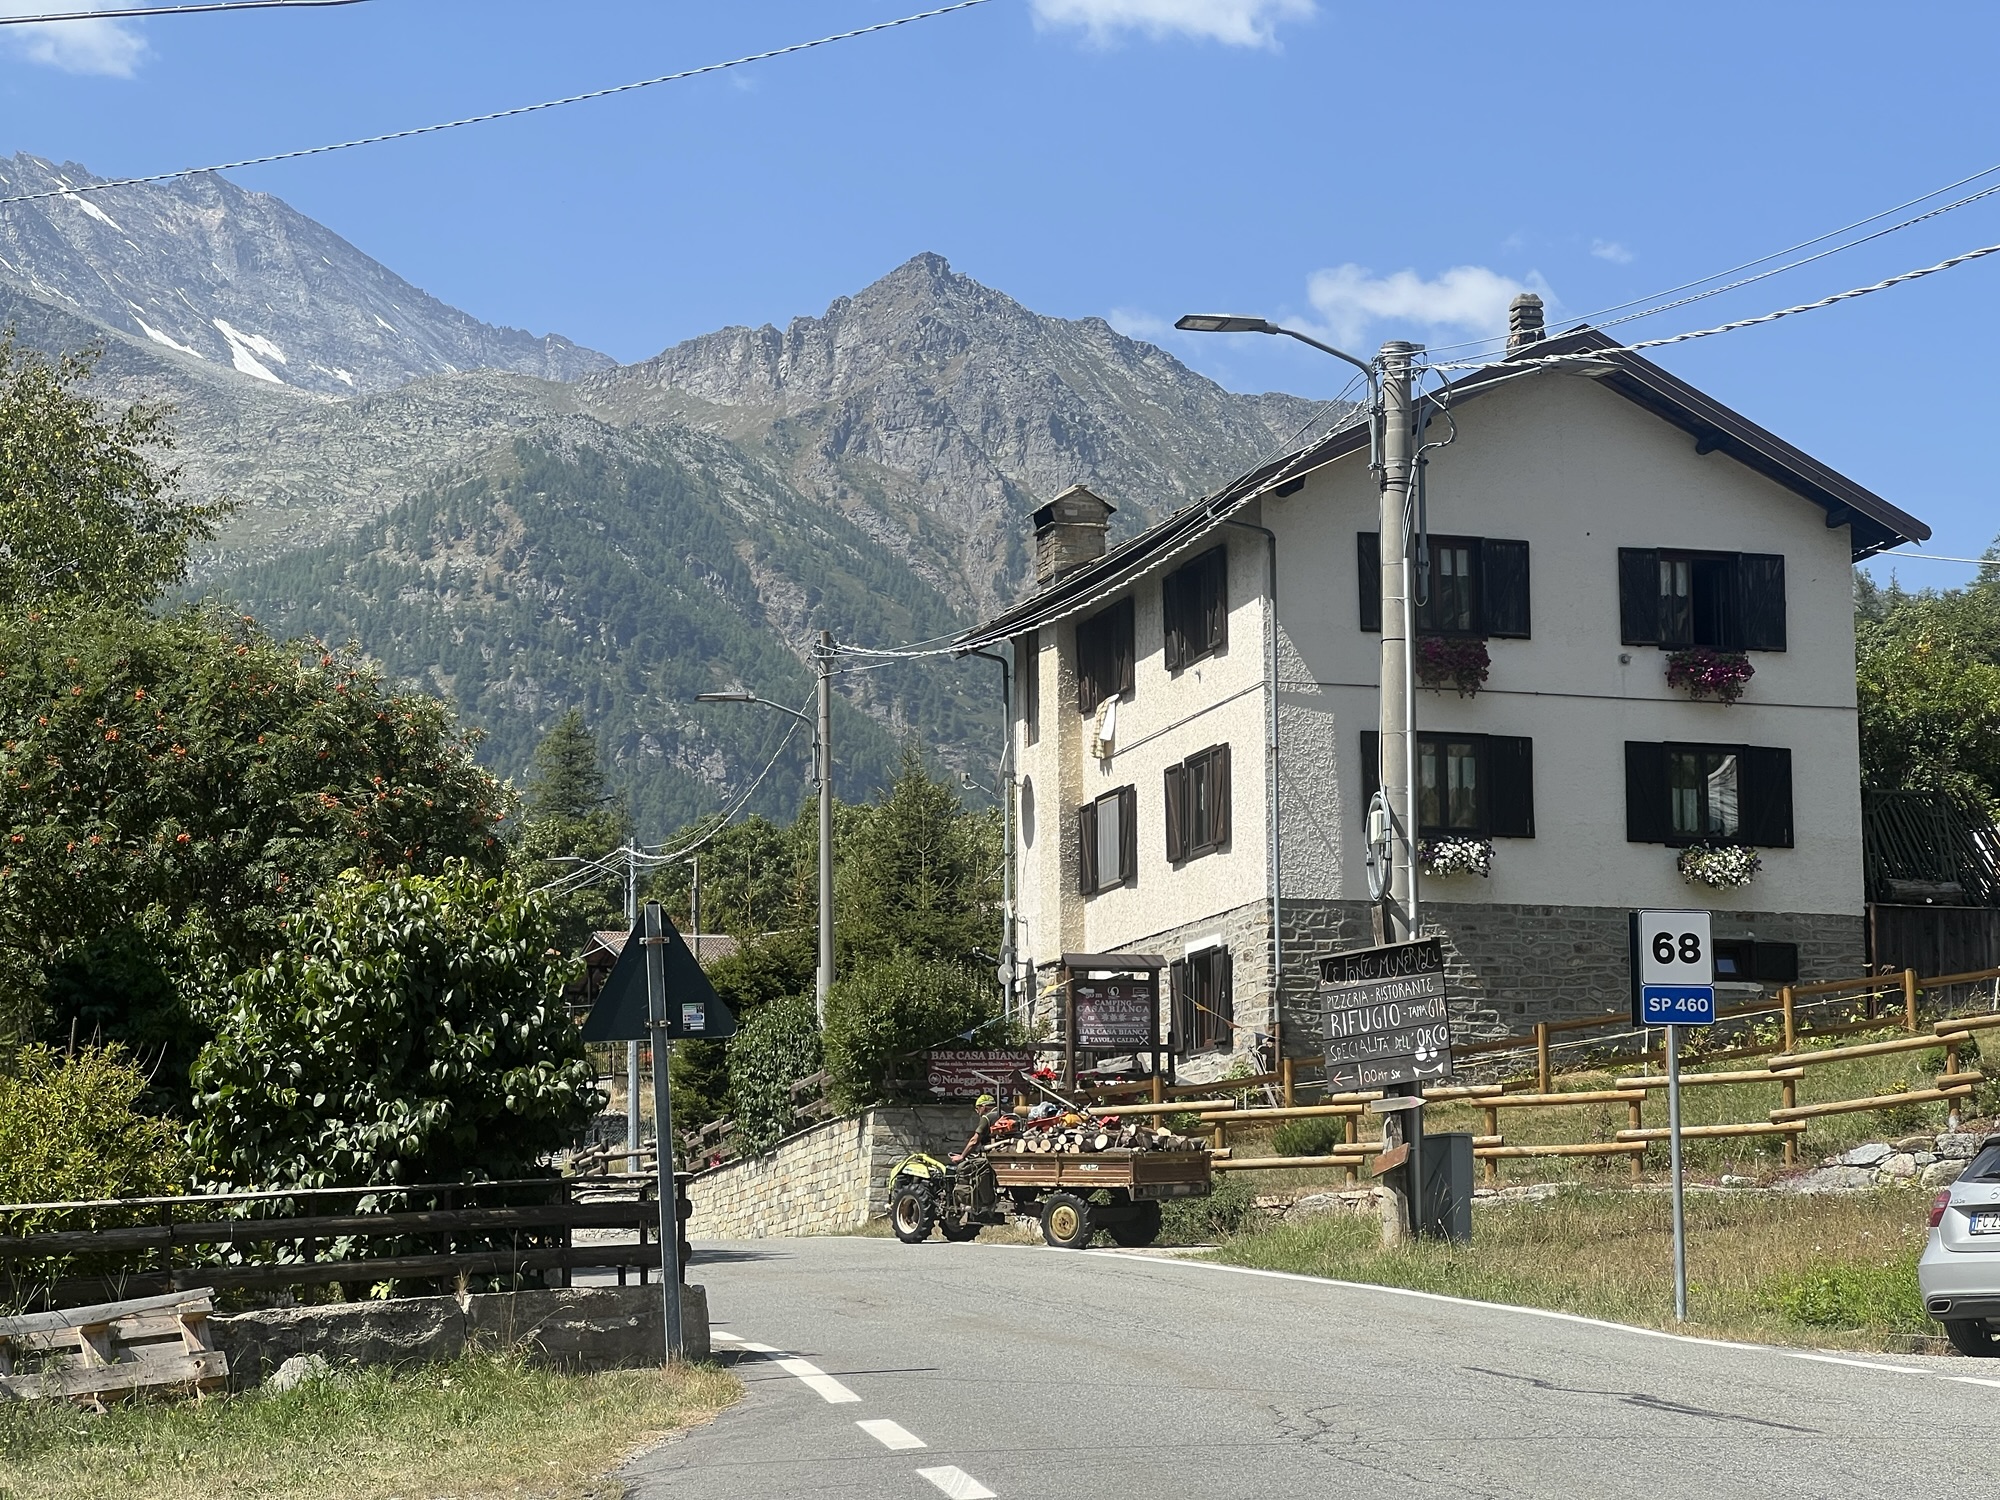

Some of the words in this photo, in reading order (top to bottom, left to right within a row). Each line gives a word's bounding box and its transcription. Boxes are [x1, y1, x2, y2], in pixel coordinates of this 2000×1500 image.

[1652, 931, 1702, 965] 68
[1320, 961, 1340, 986] LE
[1343, 953, 1374, 985] FONTI
[1377, 946, 1439, 980] MINERALI
[1326, 990, 1369, 1010] PIZZERIA
[1375, 977, 1434, 1001] RISTORANTE
[1077, 1005, 1105, 1013] CASA
[1109, 1005, 1149, 1013] BIANCA
[1648, 997, 1672, 1012] SP
[1675, 998, 1709, 1013] 460
[1330, 1003, 1401, 1037] RIFUGIO
[1408, 1004, 1428, 1019] TAPPA
[1428, 997, 1447, 1018] GTA
[931, 1051, 955, 1060] BAR
[956, 1051, 986, 1060] CASA
[987, 1051, 1030, 1060] BIANCA
[942, 1075, 984, 1086] Noleggio
[954, 1087, 980, 1096] Case
[983, 1087, 1007, 1096] POD
[1976, 1213, 1990, 1228] FC
